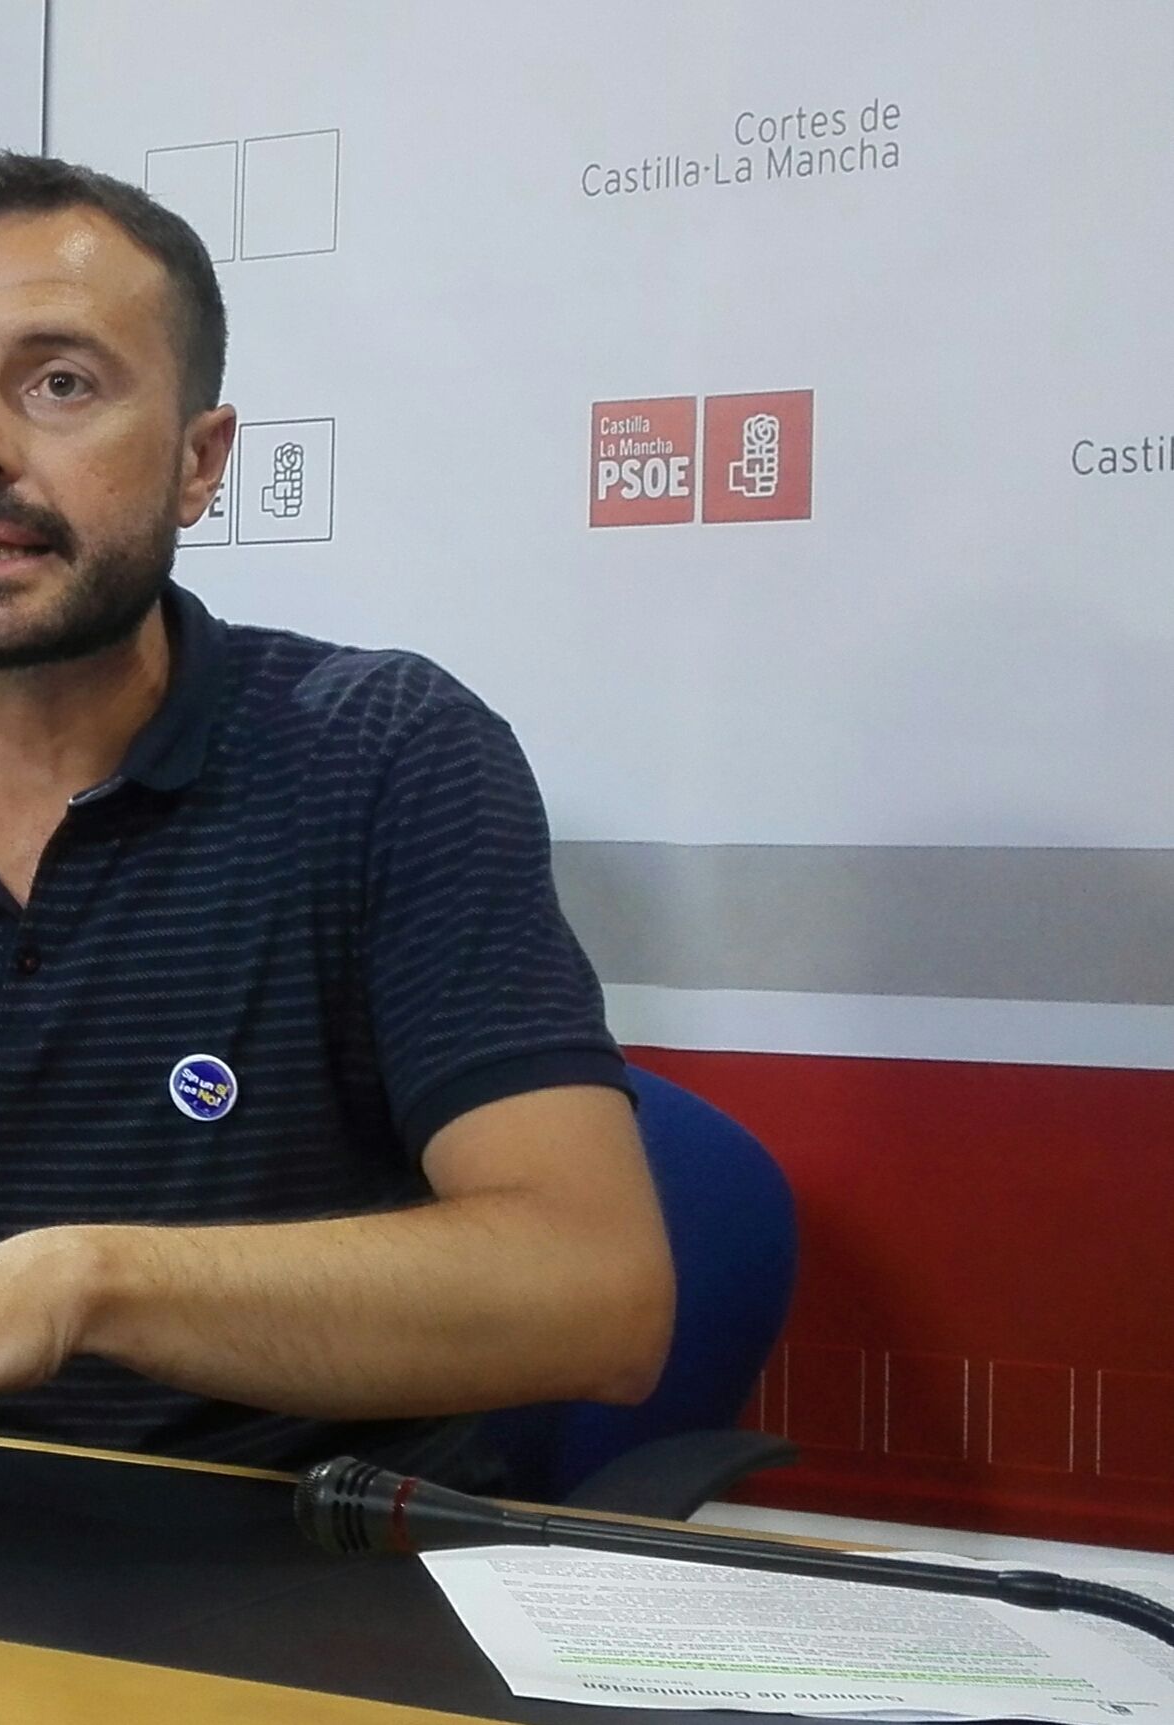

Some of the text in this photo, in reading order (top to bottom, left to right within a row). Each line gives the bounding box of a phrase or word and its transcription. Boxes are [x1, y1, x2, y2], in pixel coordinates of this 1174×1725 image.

[735, 98, 901, 146] Cortes de
[767, 137, 900, 181] Mancha
[599, 438, 673, 457] La Mancha
[600, 416, 650, 435] Castilla
[597, 456, 690, 500] PSOE
